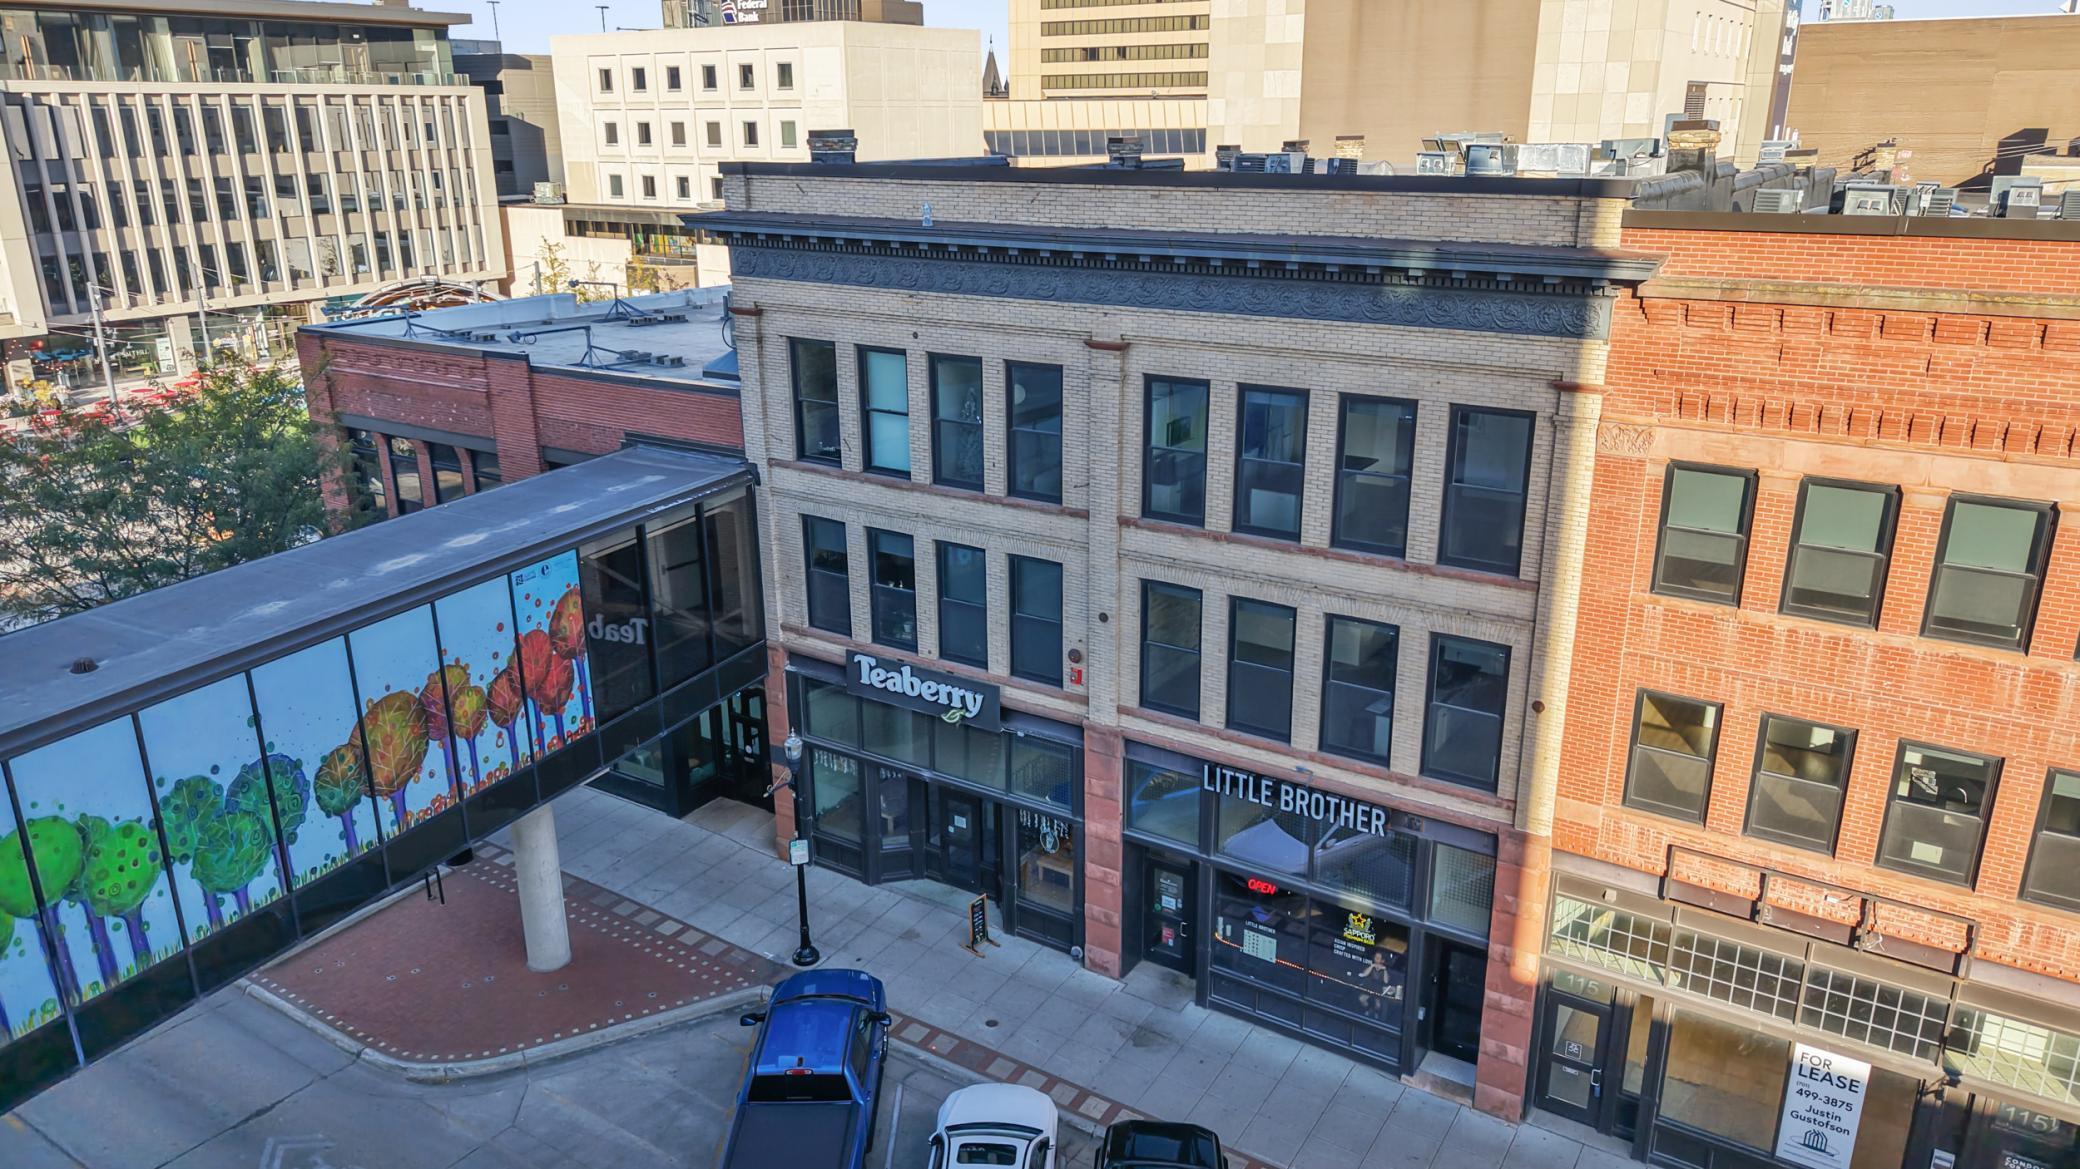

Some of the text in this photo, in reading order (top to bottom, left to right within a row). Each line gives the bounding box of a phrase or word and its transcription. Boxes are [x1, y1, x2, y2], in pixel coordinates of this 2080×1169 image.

[738, 11, 759, 22] Bank
[853, 654, 984, 718] Teaberry
[1203, 764, 1386, 837] LITTLE BROTHER
[1248, 879, 1276, 895] OPEN
[1343, 927, 1376, 941] SAPPORO
[1567, 974, 1600, 996] 115
[1800, 1052, 1833, 1071] FOR
[1798, 1063, 1861, 1094] LEASE
[1795, 1087, 1854, 1112] 499-3875
[1790, 1110, 1850, 1136] Gustofson
[1804, 1105, 1842, 1122] Justin
[2005, 1156, 2045, 1169] CONDO
